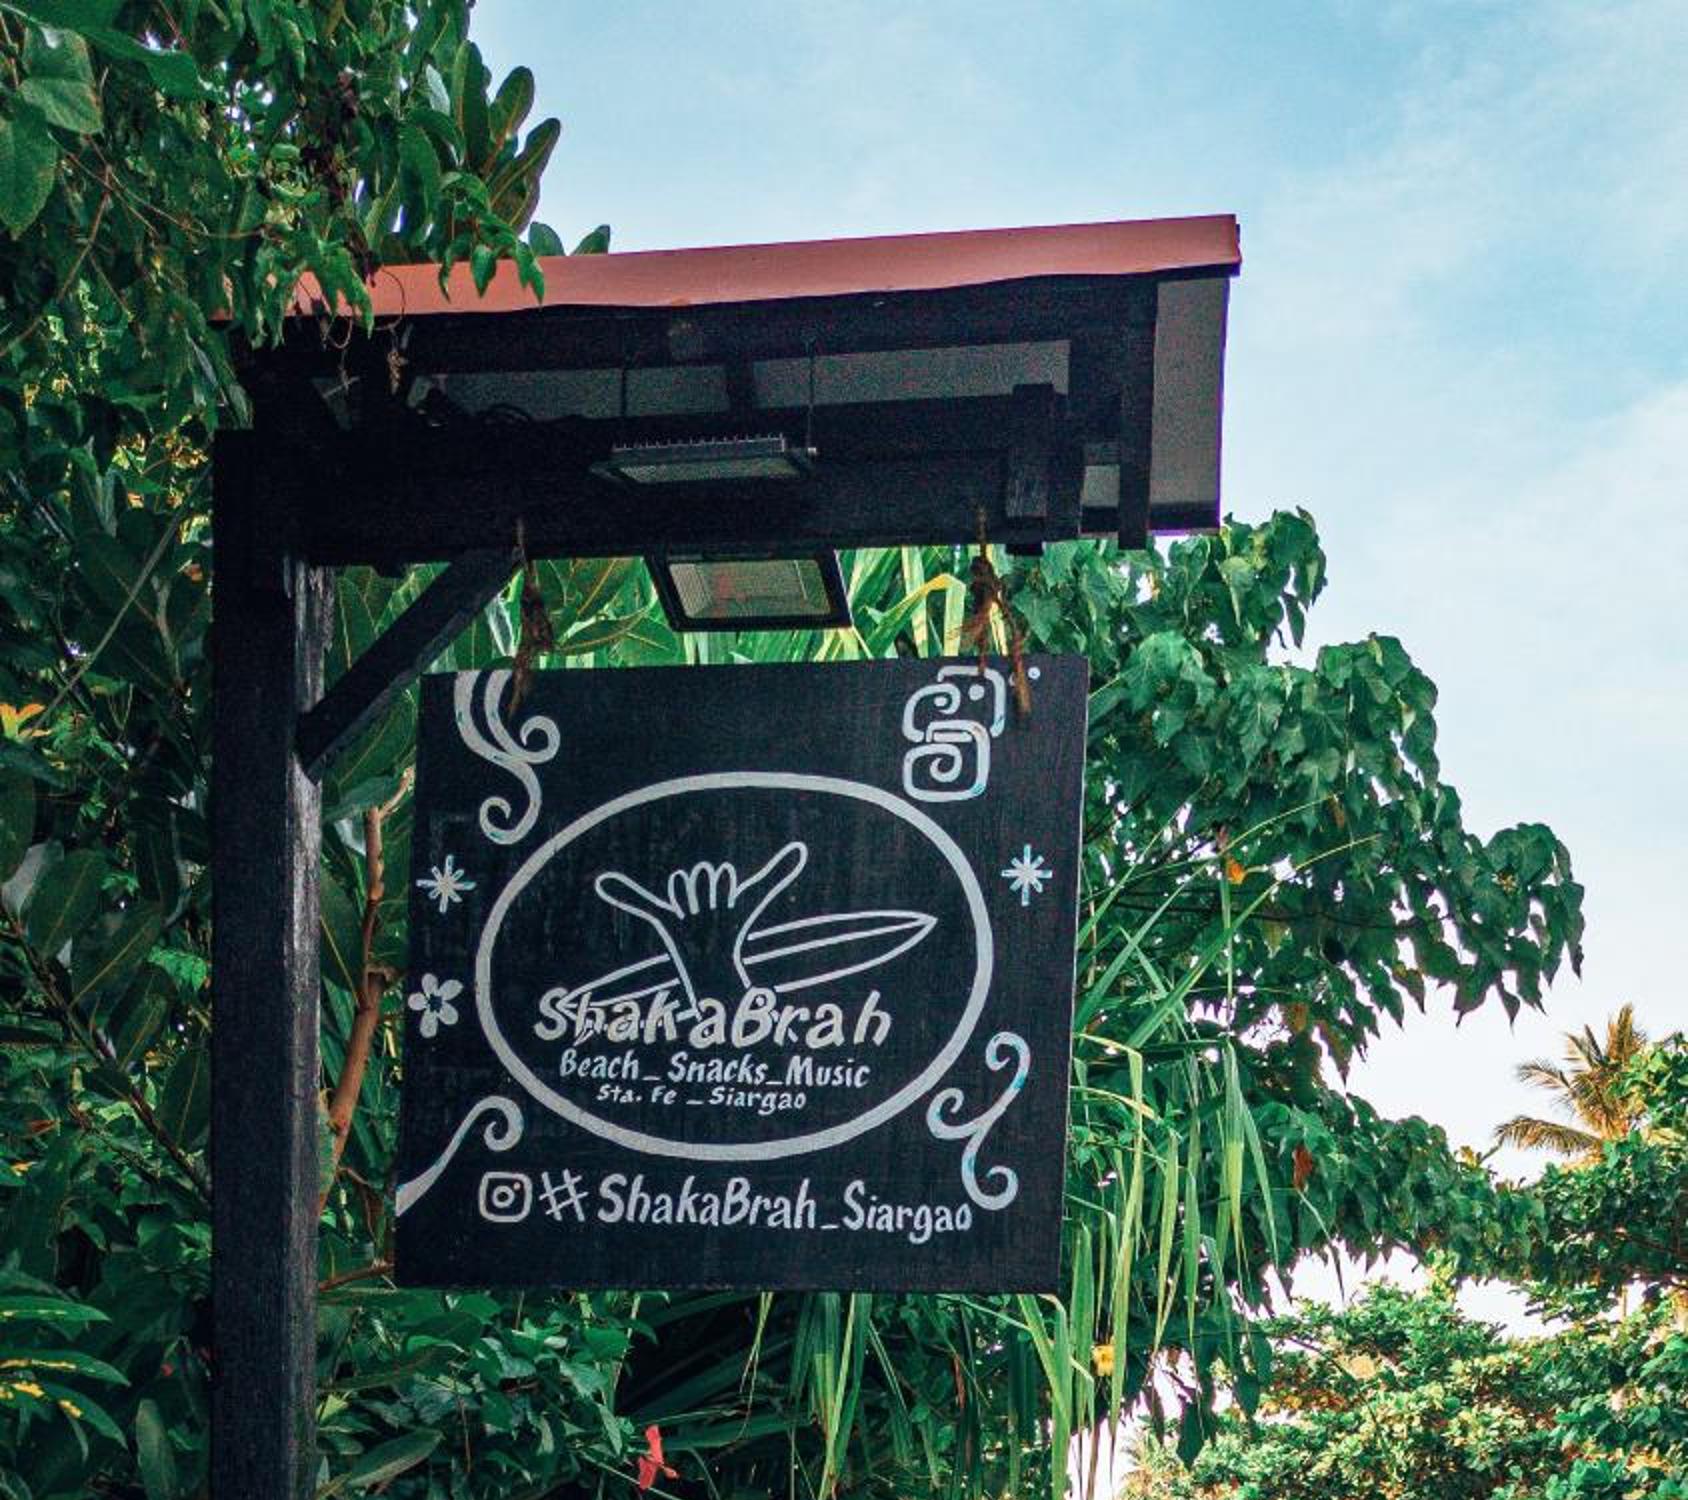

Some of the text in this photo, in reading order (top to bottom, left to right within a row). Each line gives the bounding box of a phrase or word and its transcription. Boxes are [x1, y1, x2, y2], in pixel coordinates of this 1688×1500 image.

[534, 986, 892, 1048] ShakaBrah
[597, 1083, 643, 1103] Sta.
[651, 1085, 677, 1105] Fe
